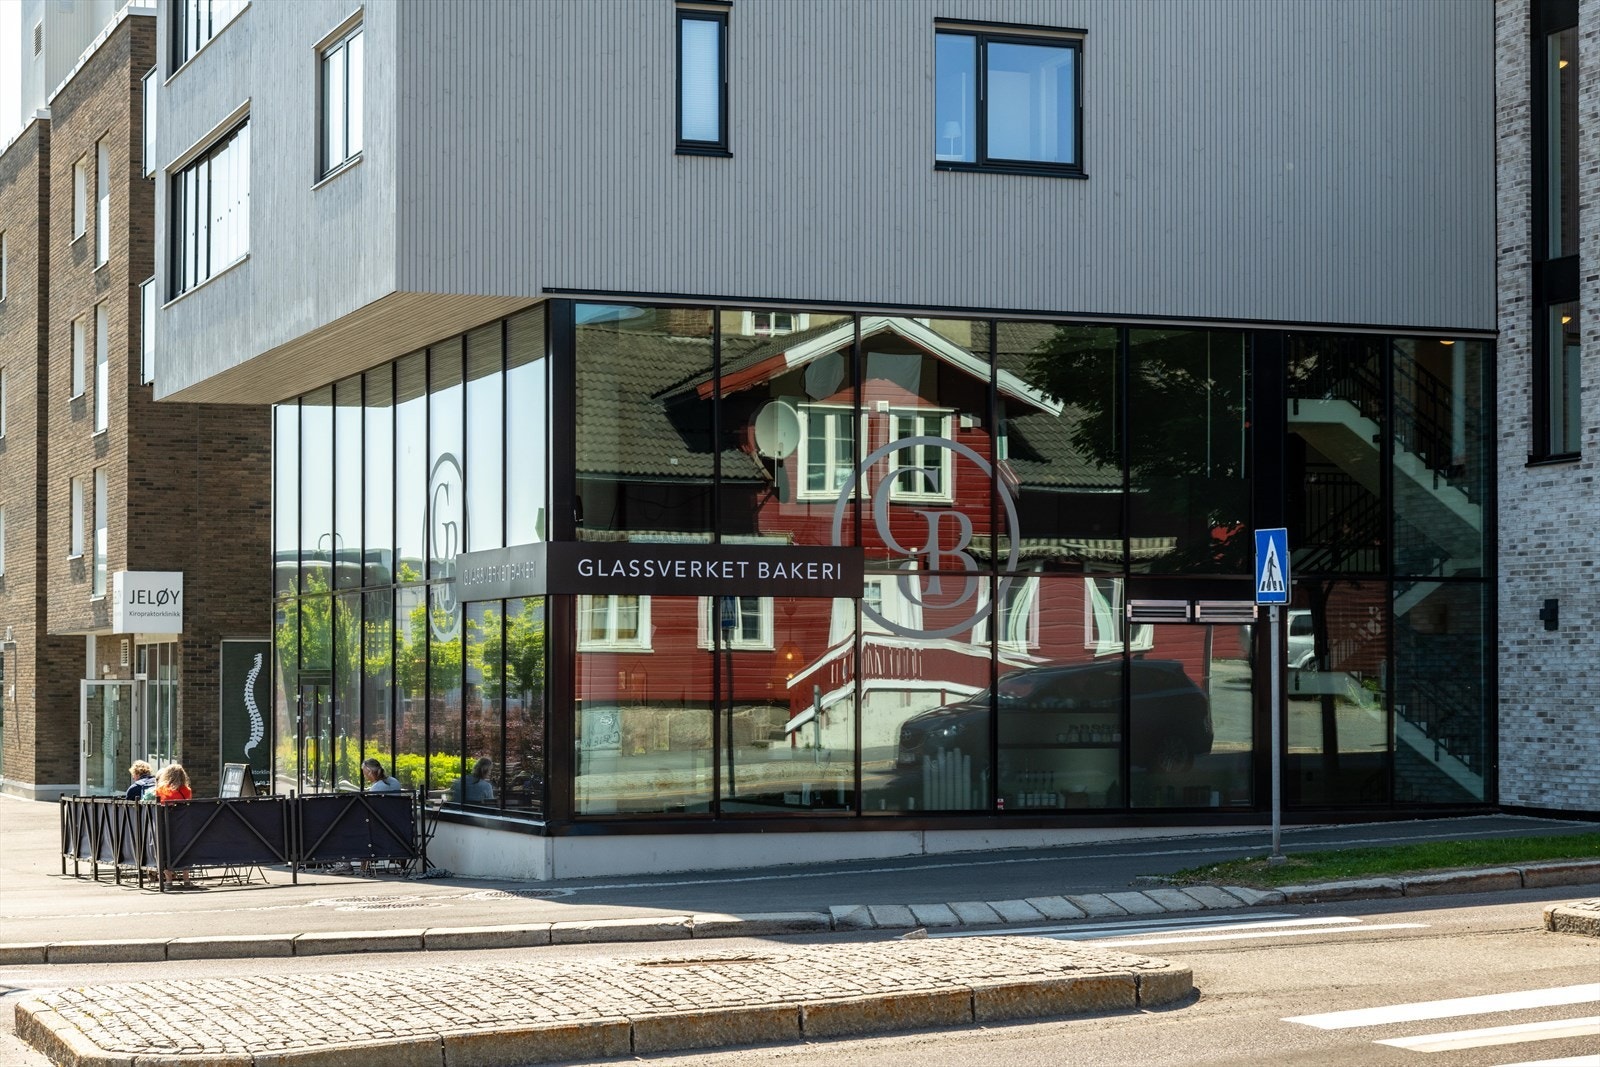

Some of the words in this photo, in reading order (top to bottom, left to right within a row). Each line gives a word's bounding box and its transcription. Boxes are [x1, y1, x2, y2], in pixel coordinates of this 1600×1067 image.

[463, 564, 510, 586] GLASSVERKET
[511, 560, 537, 580] BAKERI
[577, 558, 749, 579] GLASSVERKET
[758, 561, 841, 580] BAKERI
[129, 588, 180, 606] JELØY
